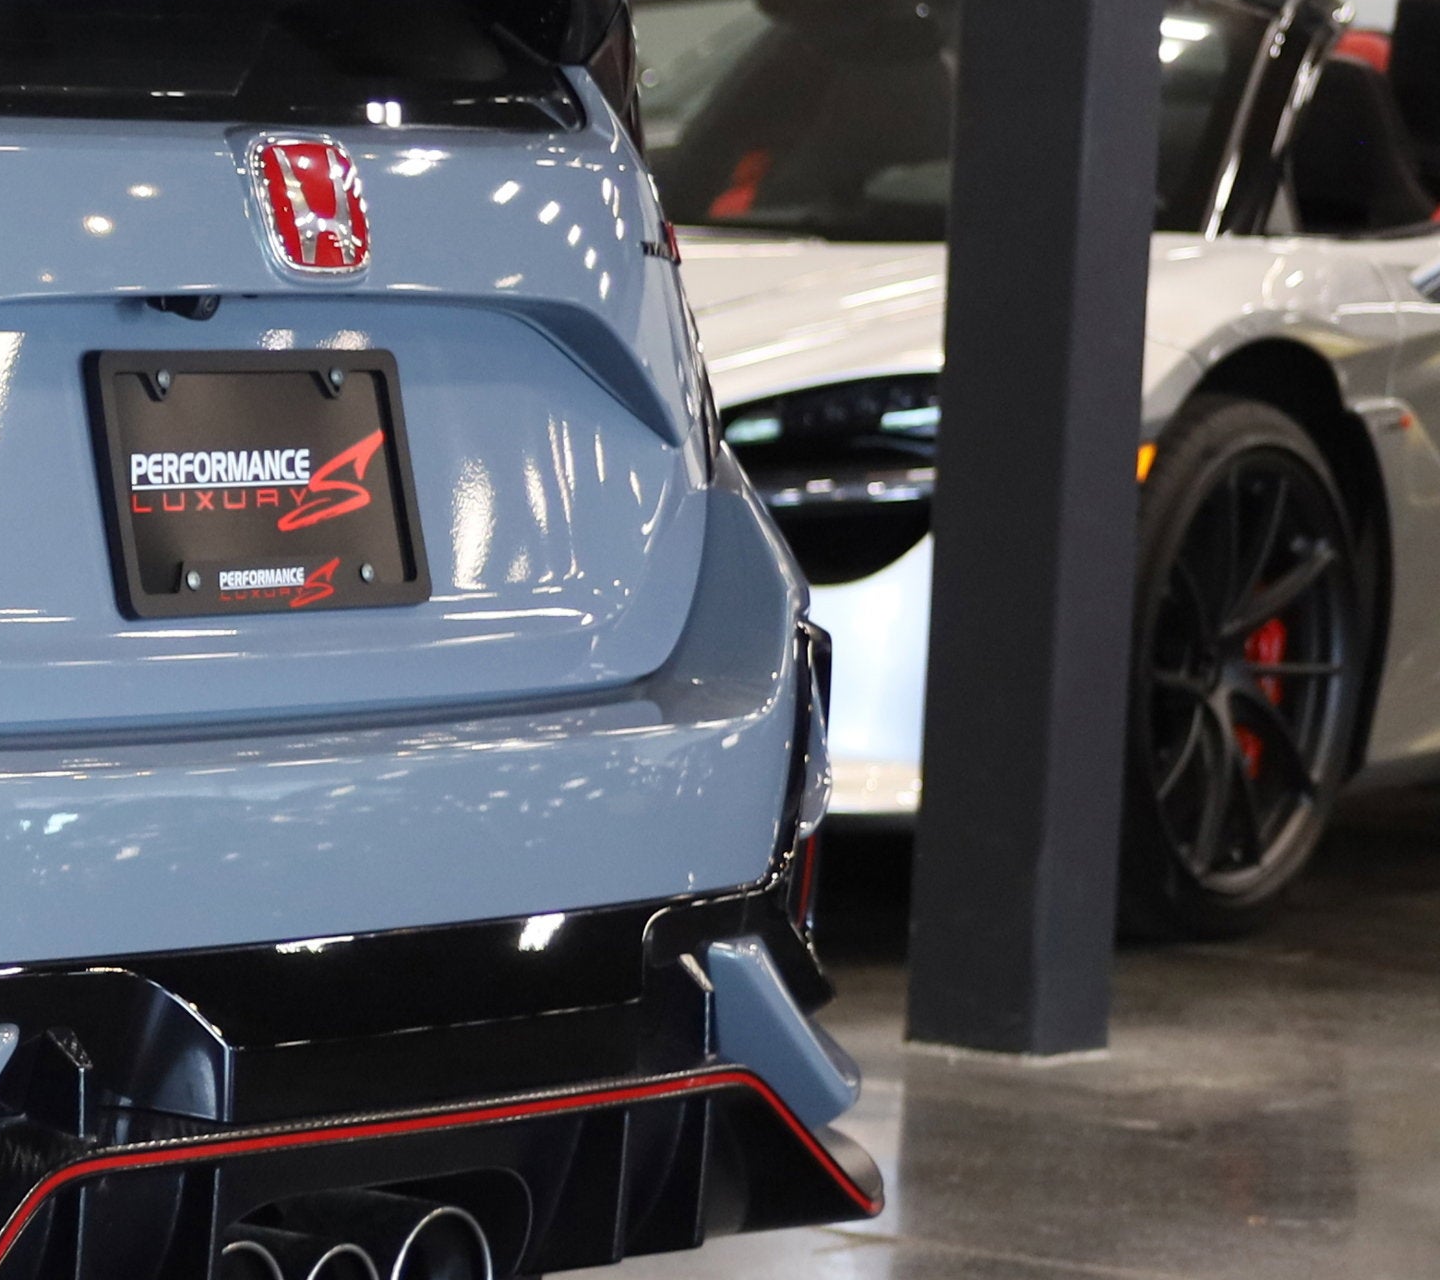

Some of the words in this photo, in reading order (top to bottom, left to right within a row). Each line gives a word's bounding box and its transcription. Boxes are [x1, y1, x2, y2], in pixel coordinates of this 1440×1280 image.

[130, 448, 311, 486] PERFORMANCE
[132, 487, 309, 513] LUXURY
[218, 566, 305, 589] PERFORMANCE
